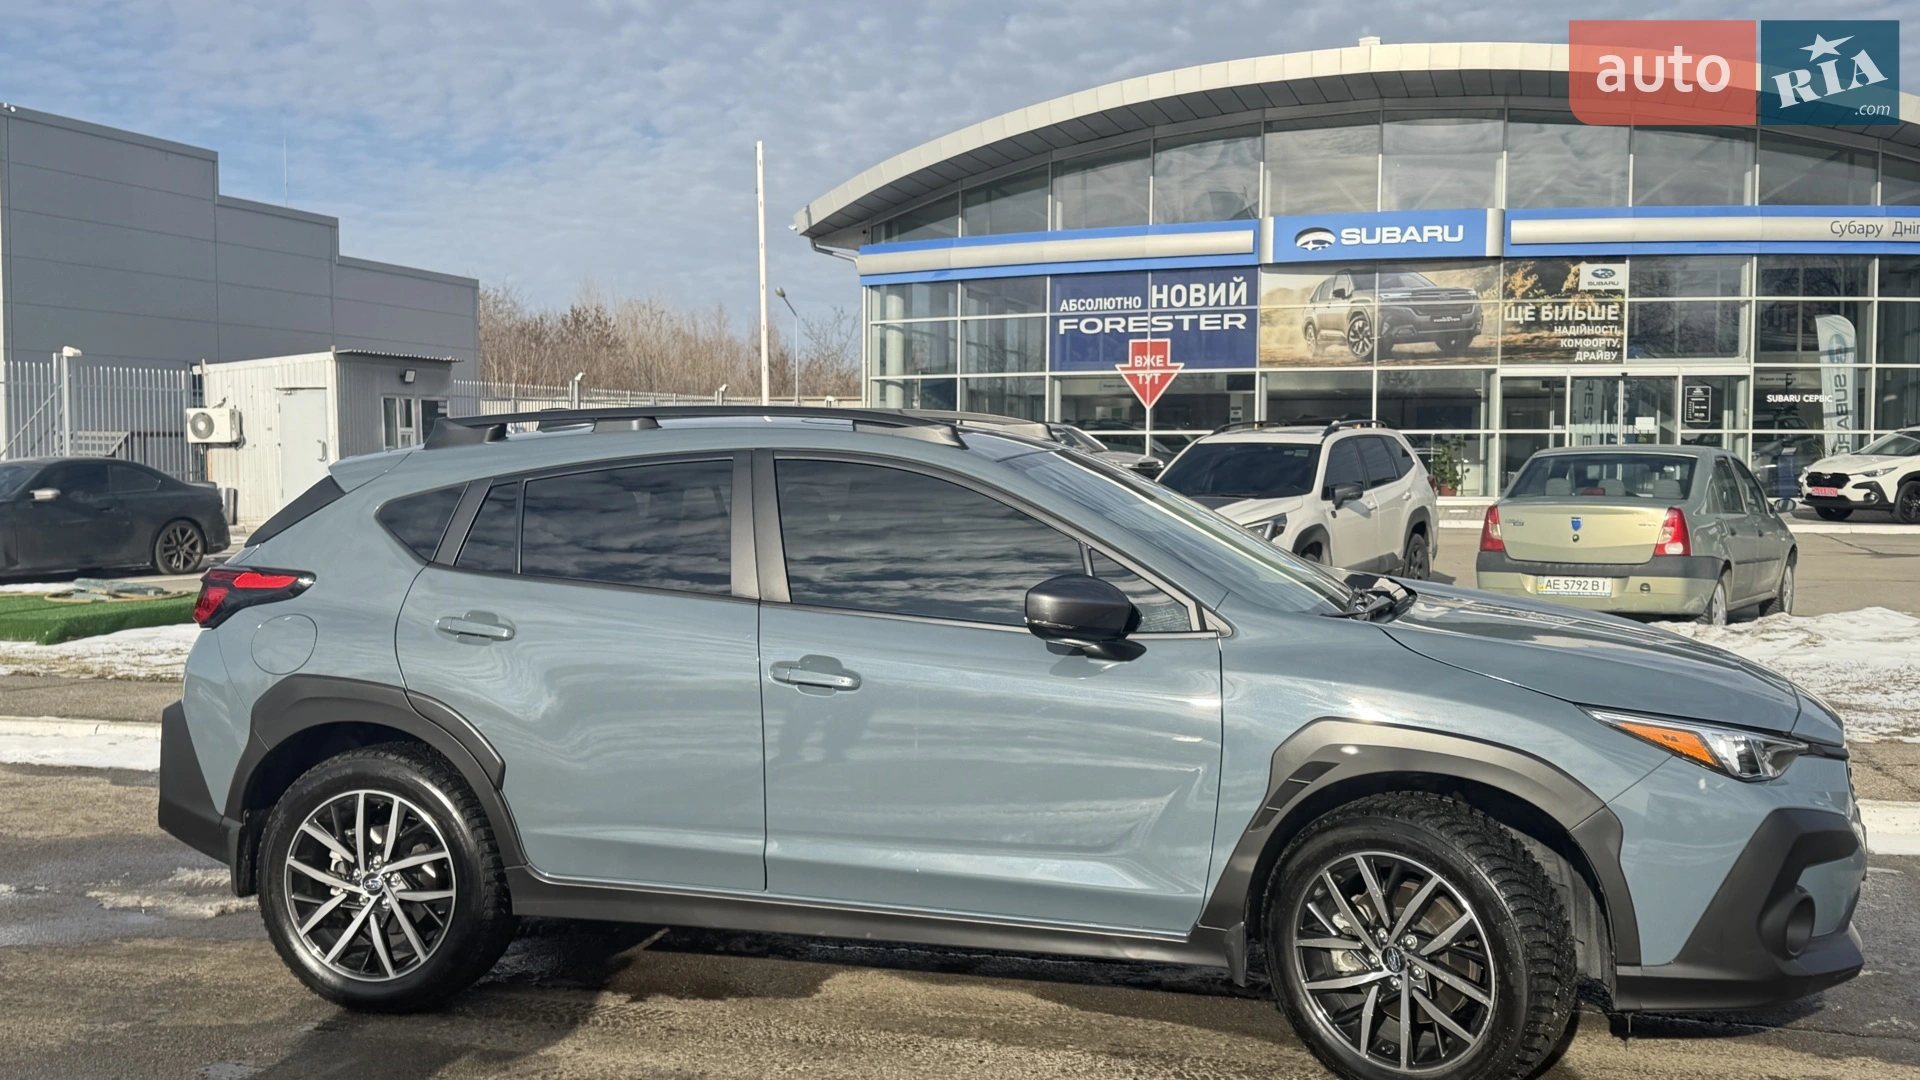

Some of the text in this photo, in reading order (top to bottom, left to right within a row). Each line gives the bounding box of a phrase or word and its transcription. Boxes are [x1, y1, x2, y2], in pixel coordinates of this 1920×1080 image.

[1340, 225, 1464, 246] SUBARU
[1830, 220, 1884, 238] Субару
[1059, 276, 1248, 312] АБСОЛЮТНО НОВИЙ
[1503, 304, 1620, 325] ЩЕ БІЛЬШЕ
[1058, 313, 1248, 335] FORESTER
[1560, 338, 1621, 349] КОМФОРТУ,
[1134, 354, 1165, 368] ВЖЕ
[1574, 349, 1618, 362] ДРАЙВУ
[1136, 373, 1162, 385] ТУТ
[1766, 394, 1801, 403] SUBARU
[1563, 579, 1589, 591] 5792
